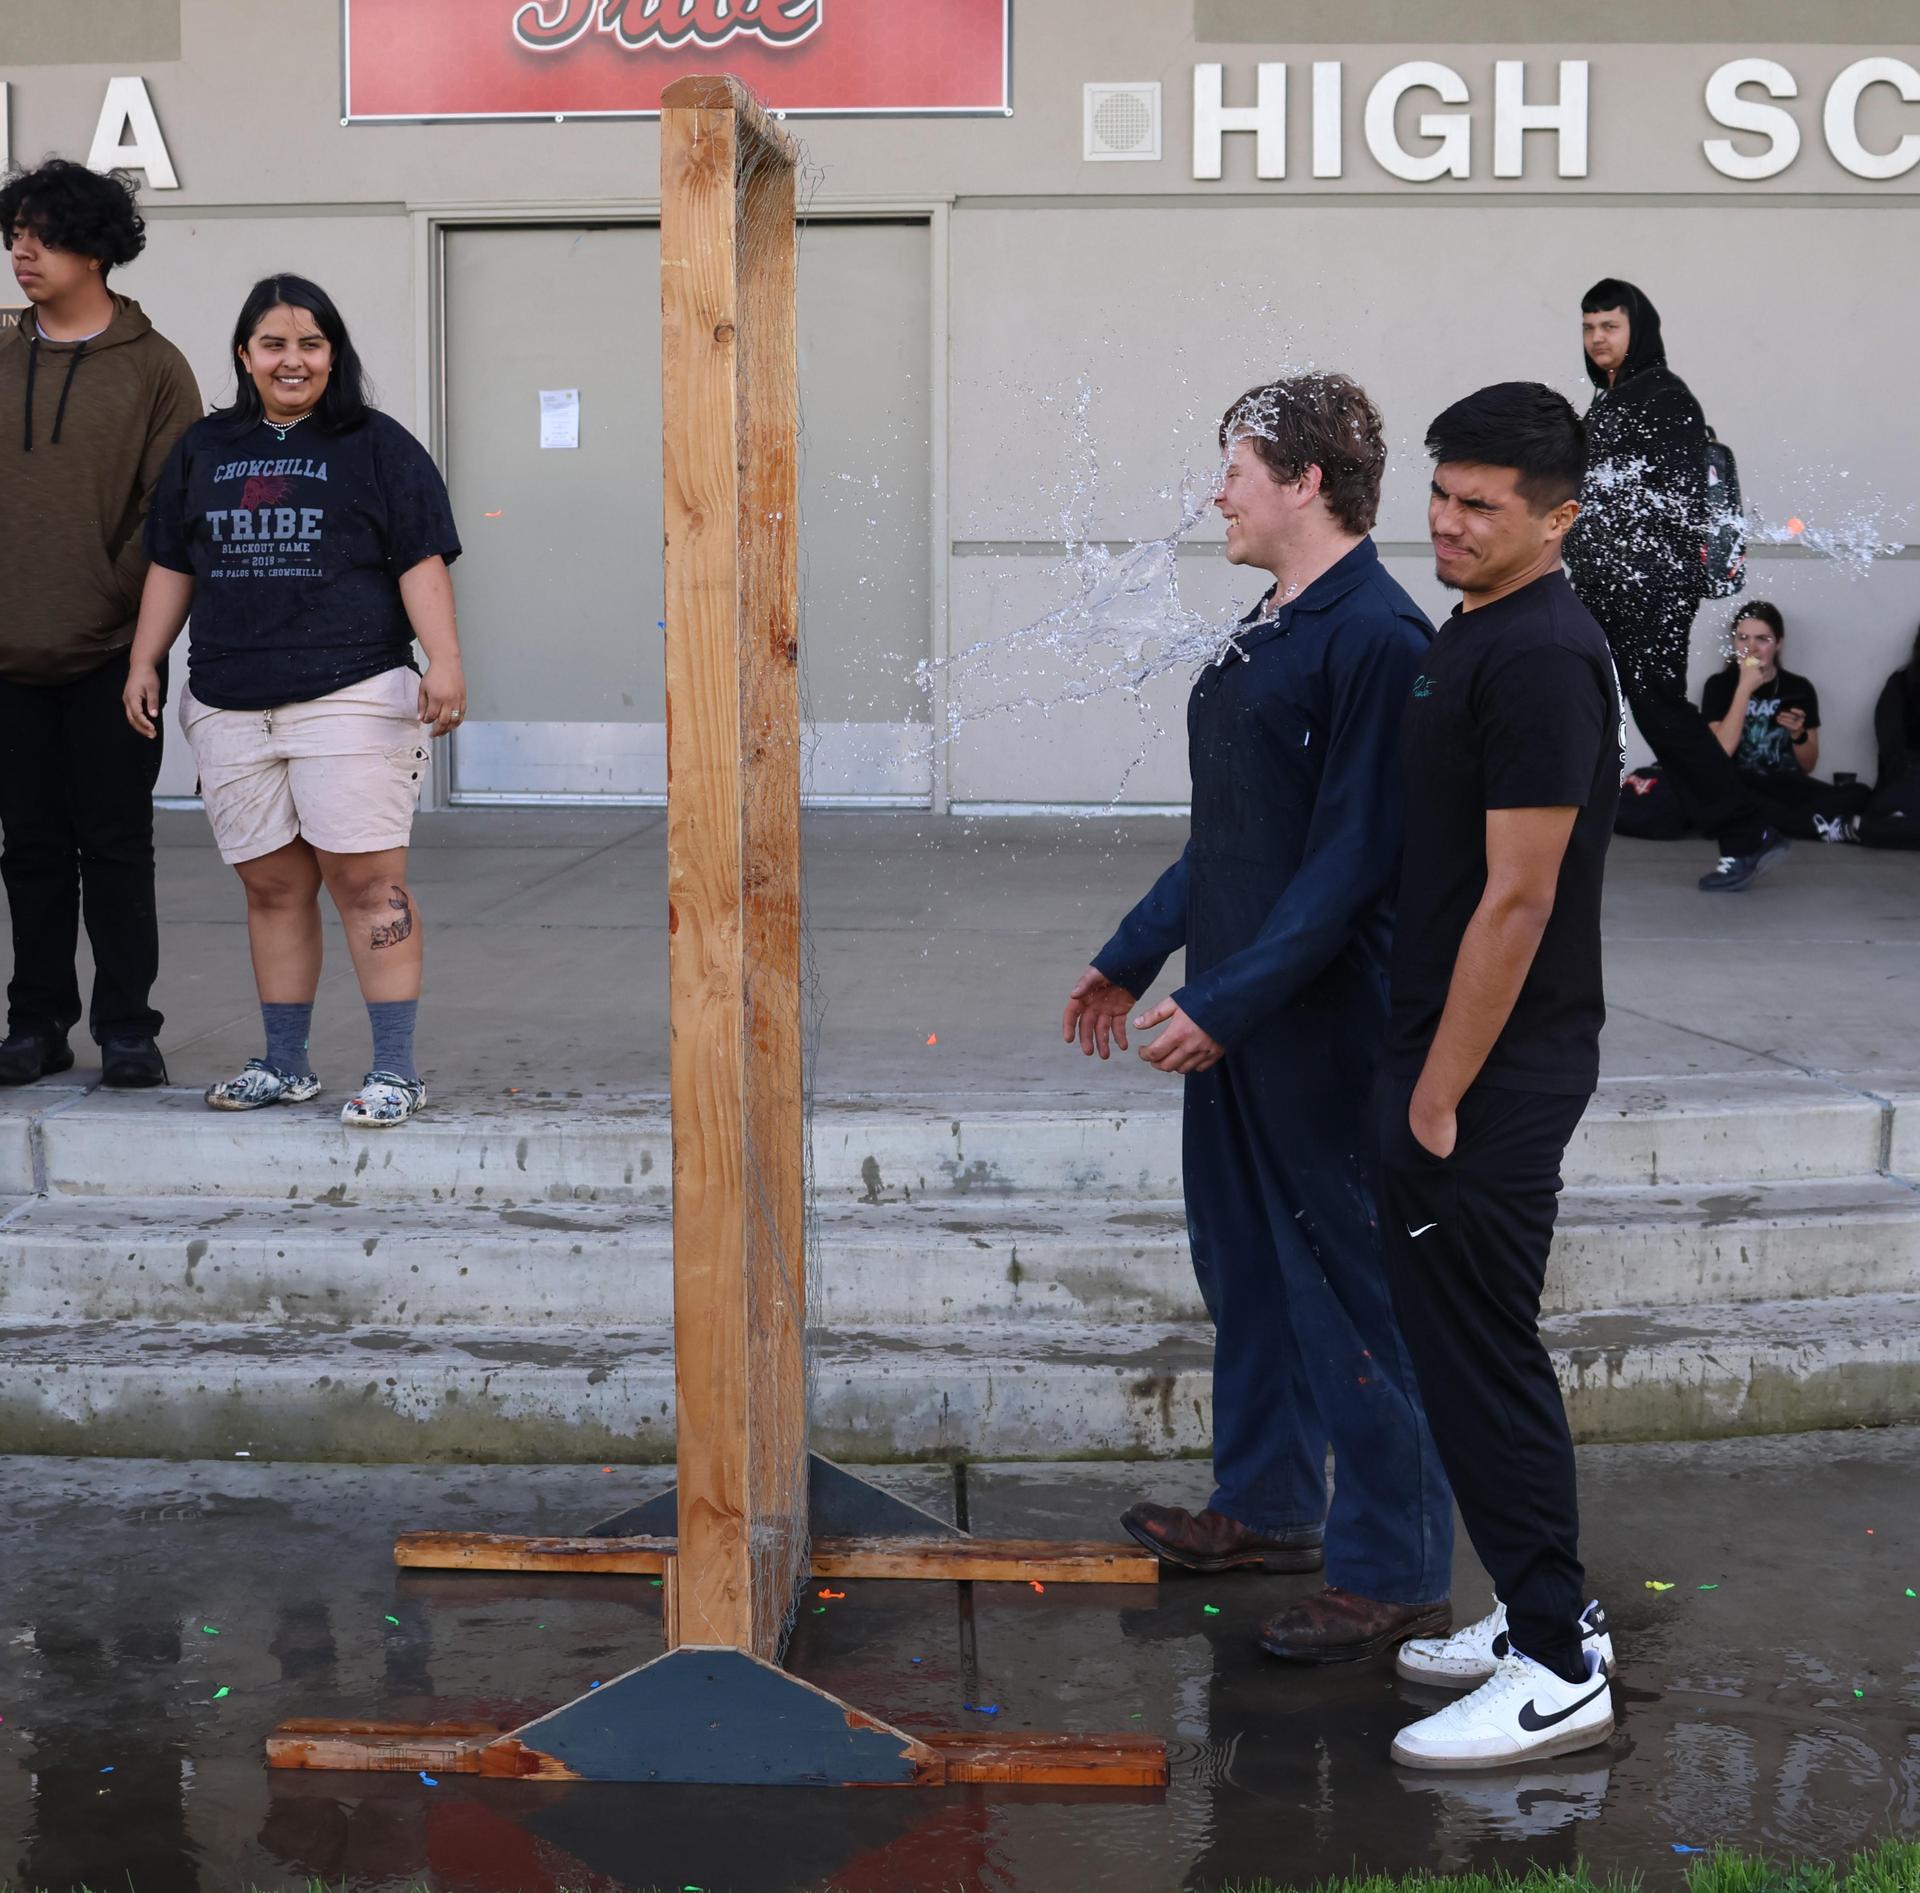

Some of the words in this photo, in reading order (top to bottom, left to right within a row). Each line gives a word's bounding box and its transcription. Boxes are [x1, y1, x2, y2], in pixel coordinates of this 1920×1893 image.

[1193, 60, 1588, 181] HIGH
[213, 458, 328, 484] CHOWCHILLA
[206, 507, 324, 541] TRIBE
[222, 543, 275, 554] BLACKOUT
[279, 542, 311, 553] GAME
[226, 569, 250, 577] PALOS
[268, 568, 323, 577] CHOWCHILLA
